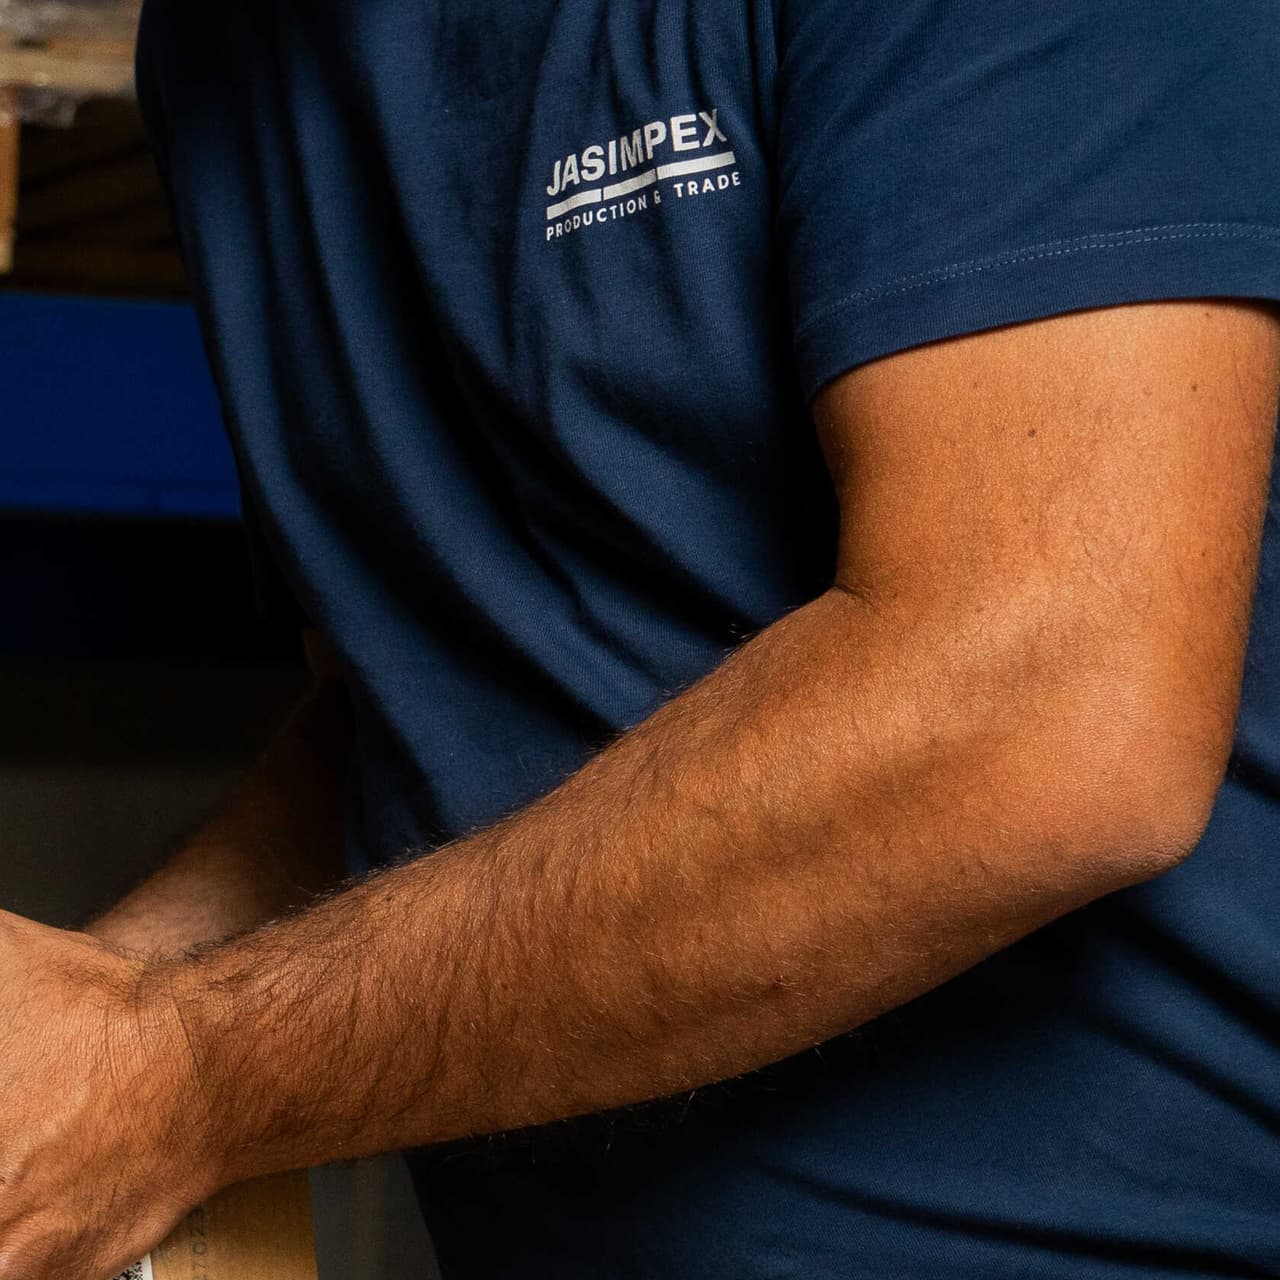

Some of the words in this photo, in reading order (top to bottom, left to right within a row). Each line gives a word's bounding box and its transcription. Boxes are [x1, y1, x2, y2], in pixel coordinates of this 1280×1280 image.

[547, 109, 728, 196] JASIMPEX
[546, 197, 648, 241] PRODUCTION
[674, 171, 741, 198] TRADE
